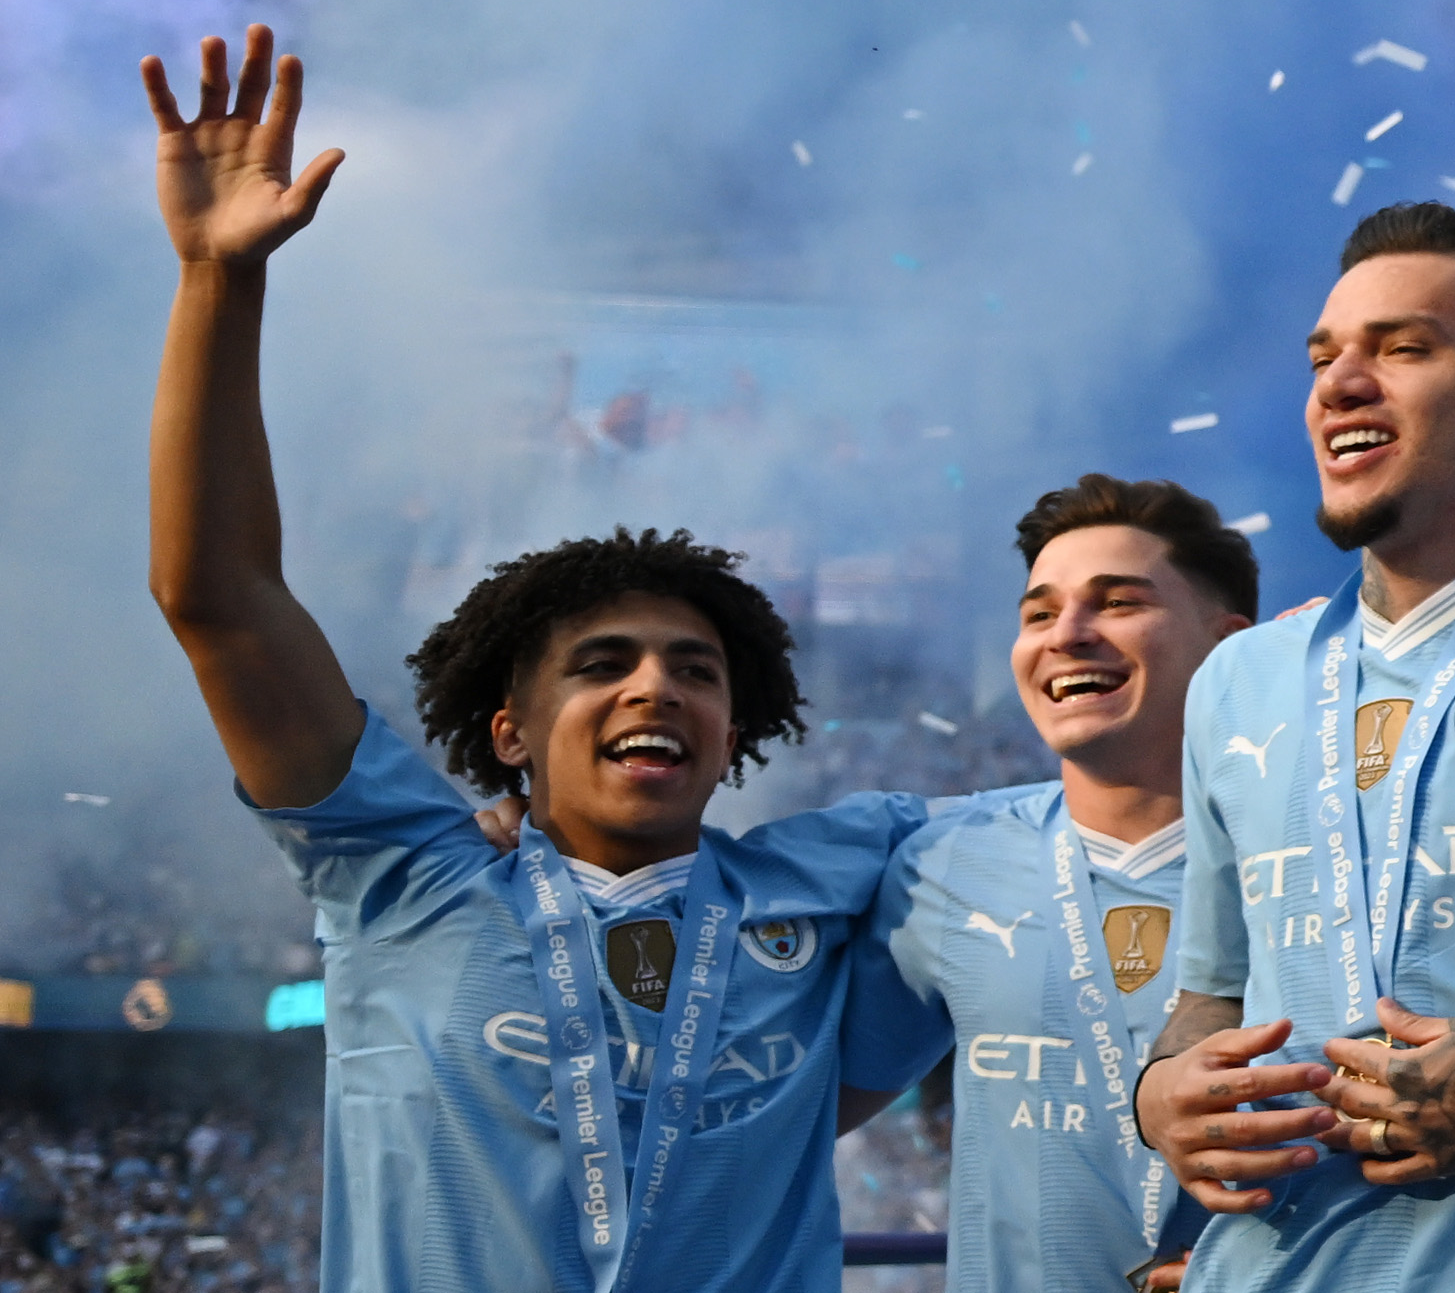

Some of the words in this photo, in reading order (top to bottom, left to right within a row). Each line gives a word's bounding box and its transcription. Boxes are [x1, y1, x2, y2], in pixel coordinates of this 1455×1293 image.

[1317, 635, 1346, 706] League
[1317, 706, 1342, 791] Premier
[1356, 755, 1387, 770] FIFA
[1384, 756, 1417, 846] Premier
[1332, 831, 1353, 926] League
[523, 848, 559, 916] Premier
[548, 919, 579, 1008] League
[689, 904, 728, 989] Premier
[1060, 901, 1095, 981] Premier
[1114, 958, 1148, 972] FIFA
[631, 978, 665, 995] FIFA
[1341, 929, 1365, 1024] Premier
[671, 991, 712, 1079] League
[1091, 1020, 1131, 1111] League
[569, 1055, 597, 1147] Premier
[583, 1150, 609, 1247] League
